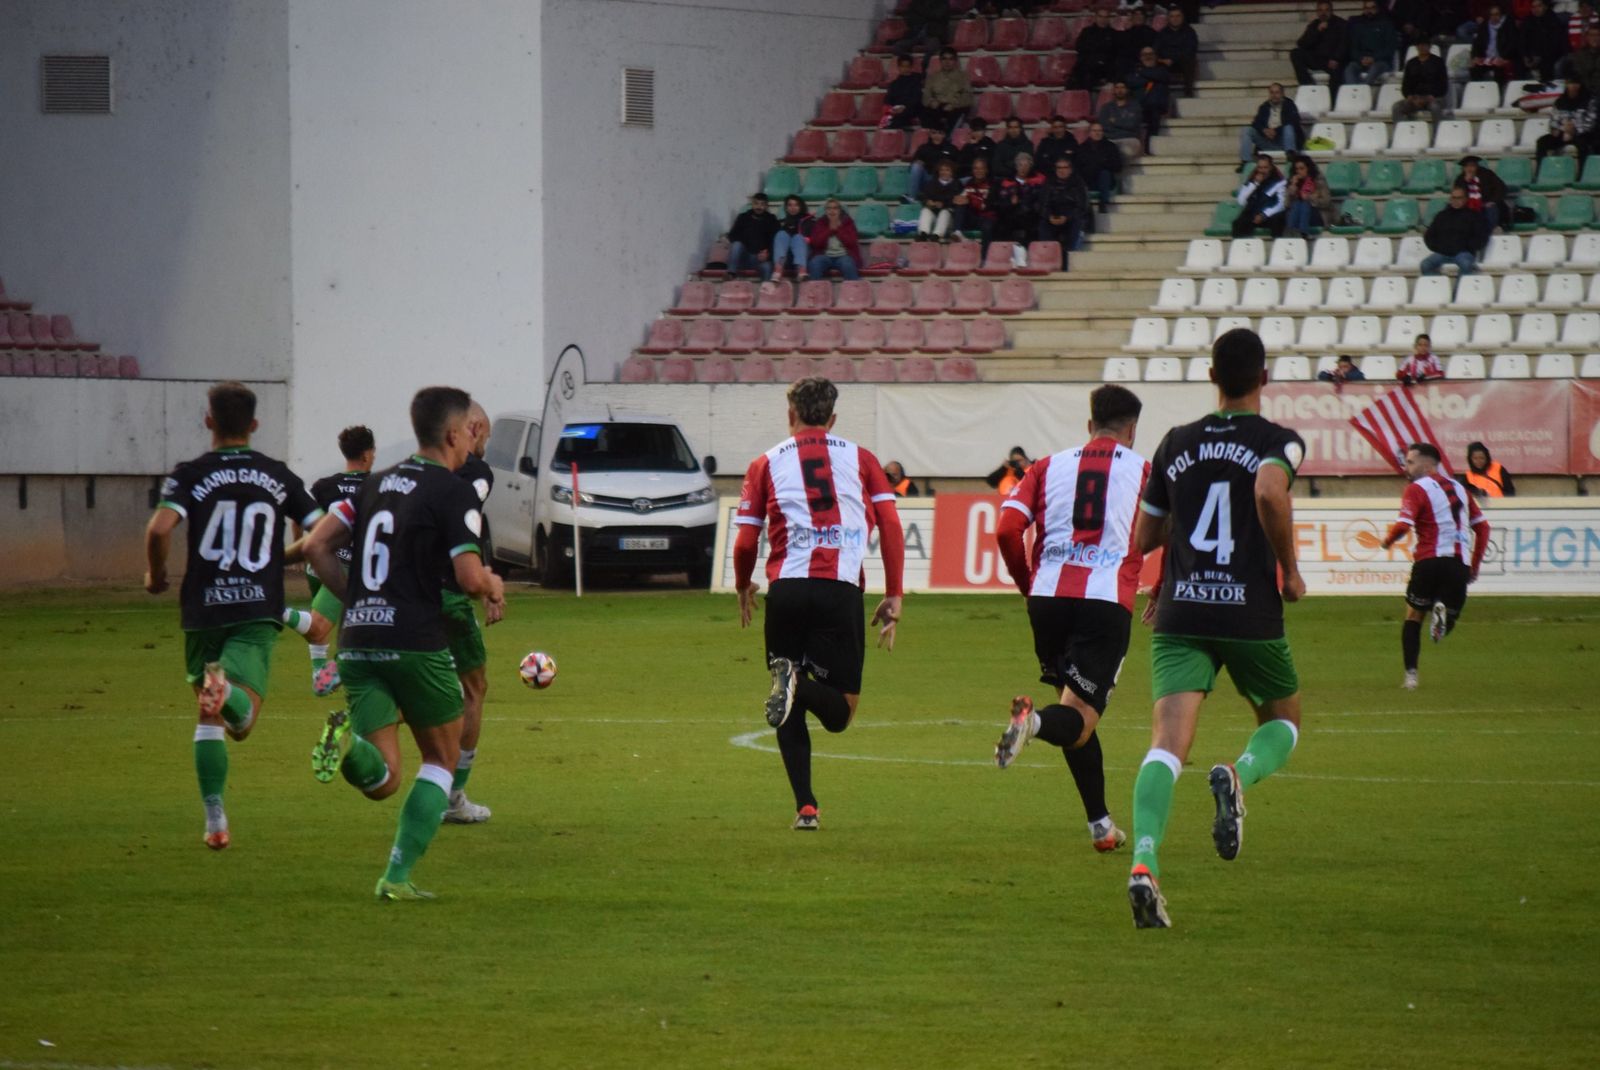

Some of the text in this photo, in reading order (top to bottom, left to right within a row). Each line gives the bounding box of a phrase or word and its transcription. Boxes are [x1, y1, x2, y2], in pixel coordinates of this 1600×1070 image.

[1166, 442, 1261, 482] POL MORENO
[191, 467, 288, 505] MARIO GARCÍA
[803, 459, 833, 512] 5
[1072, 469, 1107, 531] 8
[199, 500, 276, 573] 40
[1190, 481, 1235, 565] 4
[361, 510, 394, 592] 6
[1068, 541, 1120, 566] HGM
[204, 584, 266, 603] PASTOR
[1174, 583, 1246, 602] PASTOR
